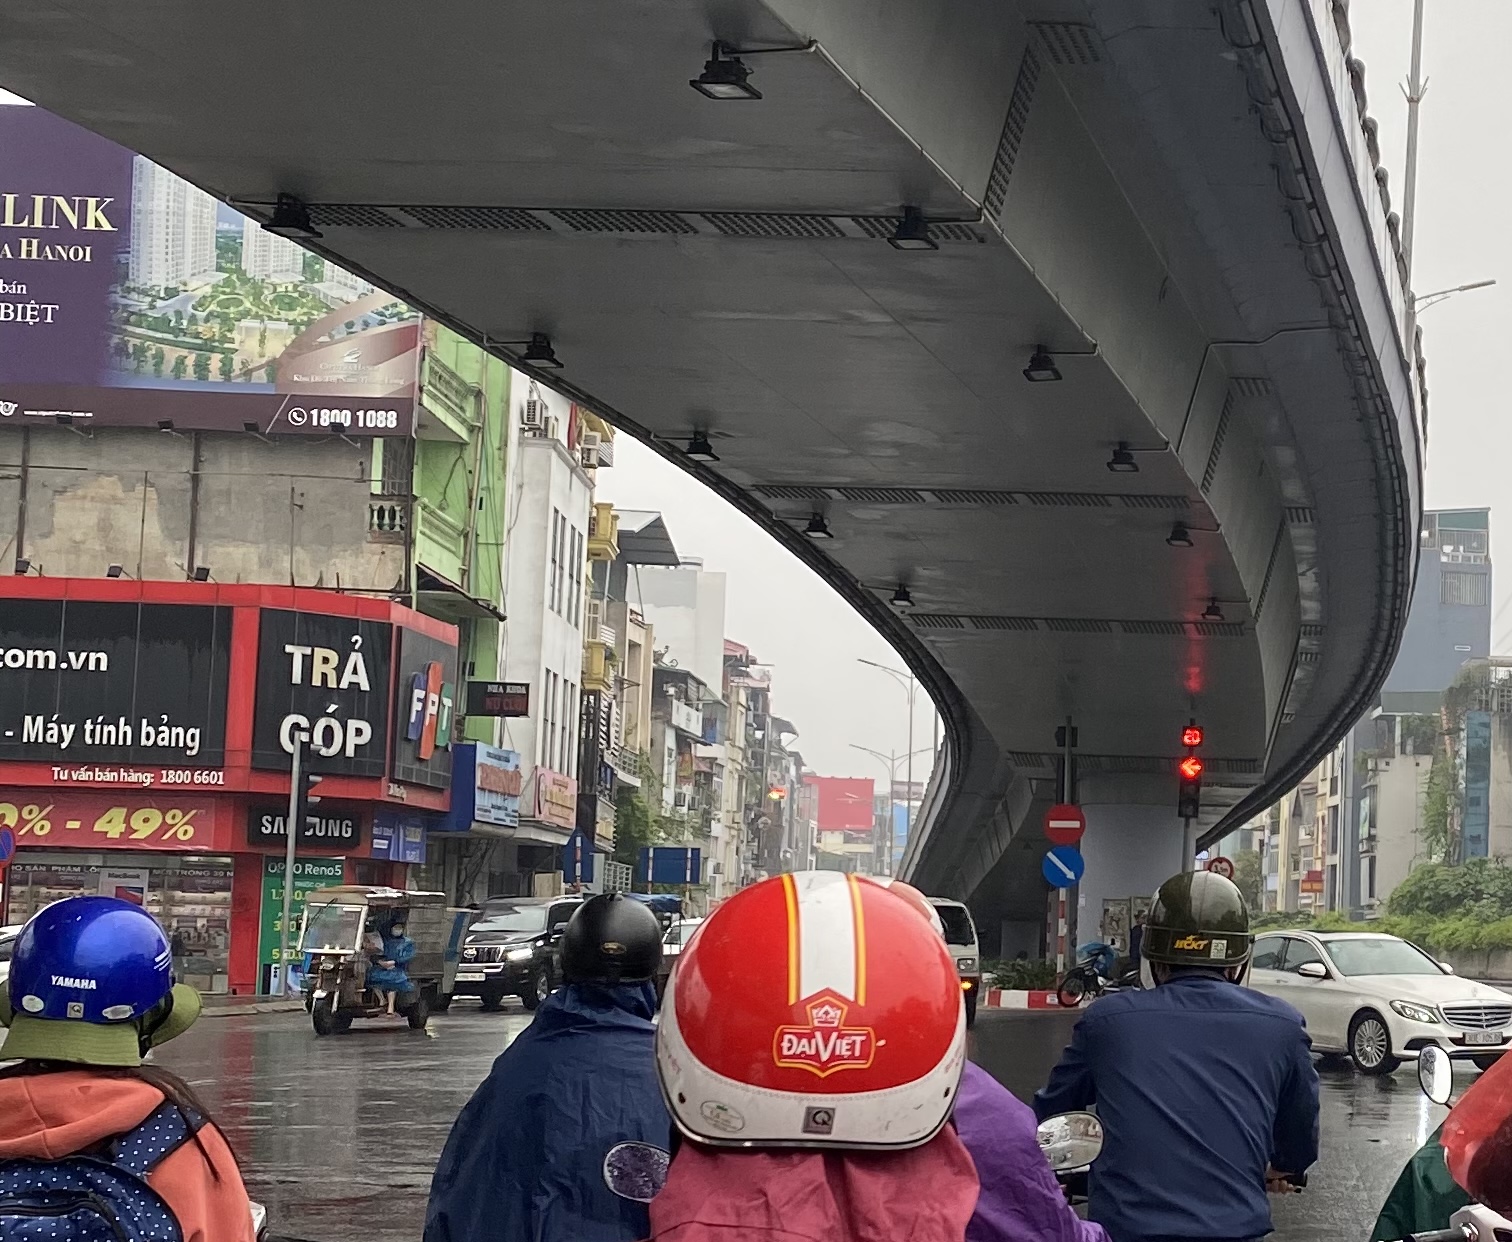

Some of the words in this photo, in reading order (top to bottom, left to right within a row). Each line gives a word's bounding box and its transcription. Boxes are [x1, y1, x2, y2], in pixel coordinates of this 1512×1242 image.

[1, 192, 118, 231] LINK
[0, 279, 27, 295] bán
[0, 299, 59, 326] BIỆT
[310, 408, 352, 427] 1800
[356, 409, 398, 428] 1088
[0, 648, 108, 671] om.vn
[285, 635, 370, 691] TRẢ
[408, 688, 452, 731] FPT
[22, 714, 75, 749] Máy
[84, 716, 132, 746] tính
[140, 715, 200, 755] bảng
[280, 704, 372, 757] GÓP
[71, 766, 93, 781] vấn
[94, 767, 118, 782] bán
[119, 769, 154, 786] hàng:
[160, 770, 192, 784] 1800
[193, 770, 225, 785] 6601
[93, 806, 197, 840] 49%
[261, 814, 353, 838] SAUNG
[268, 862, 302, 874] OPO
[305, 863, 342, 876] Reno5
[51, 975, 97, 990] YAMAHA
[813, 1110, 831, 1126] Q
